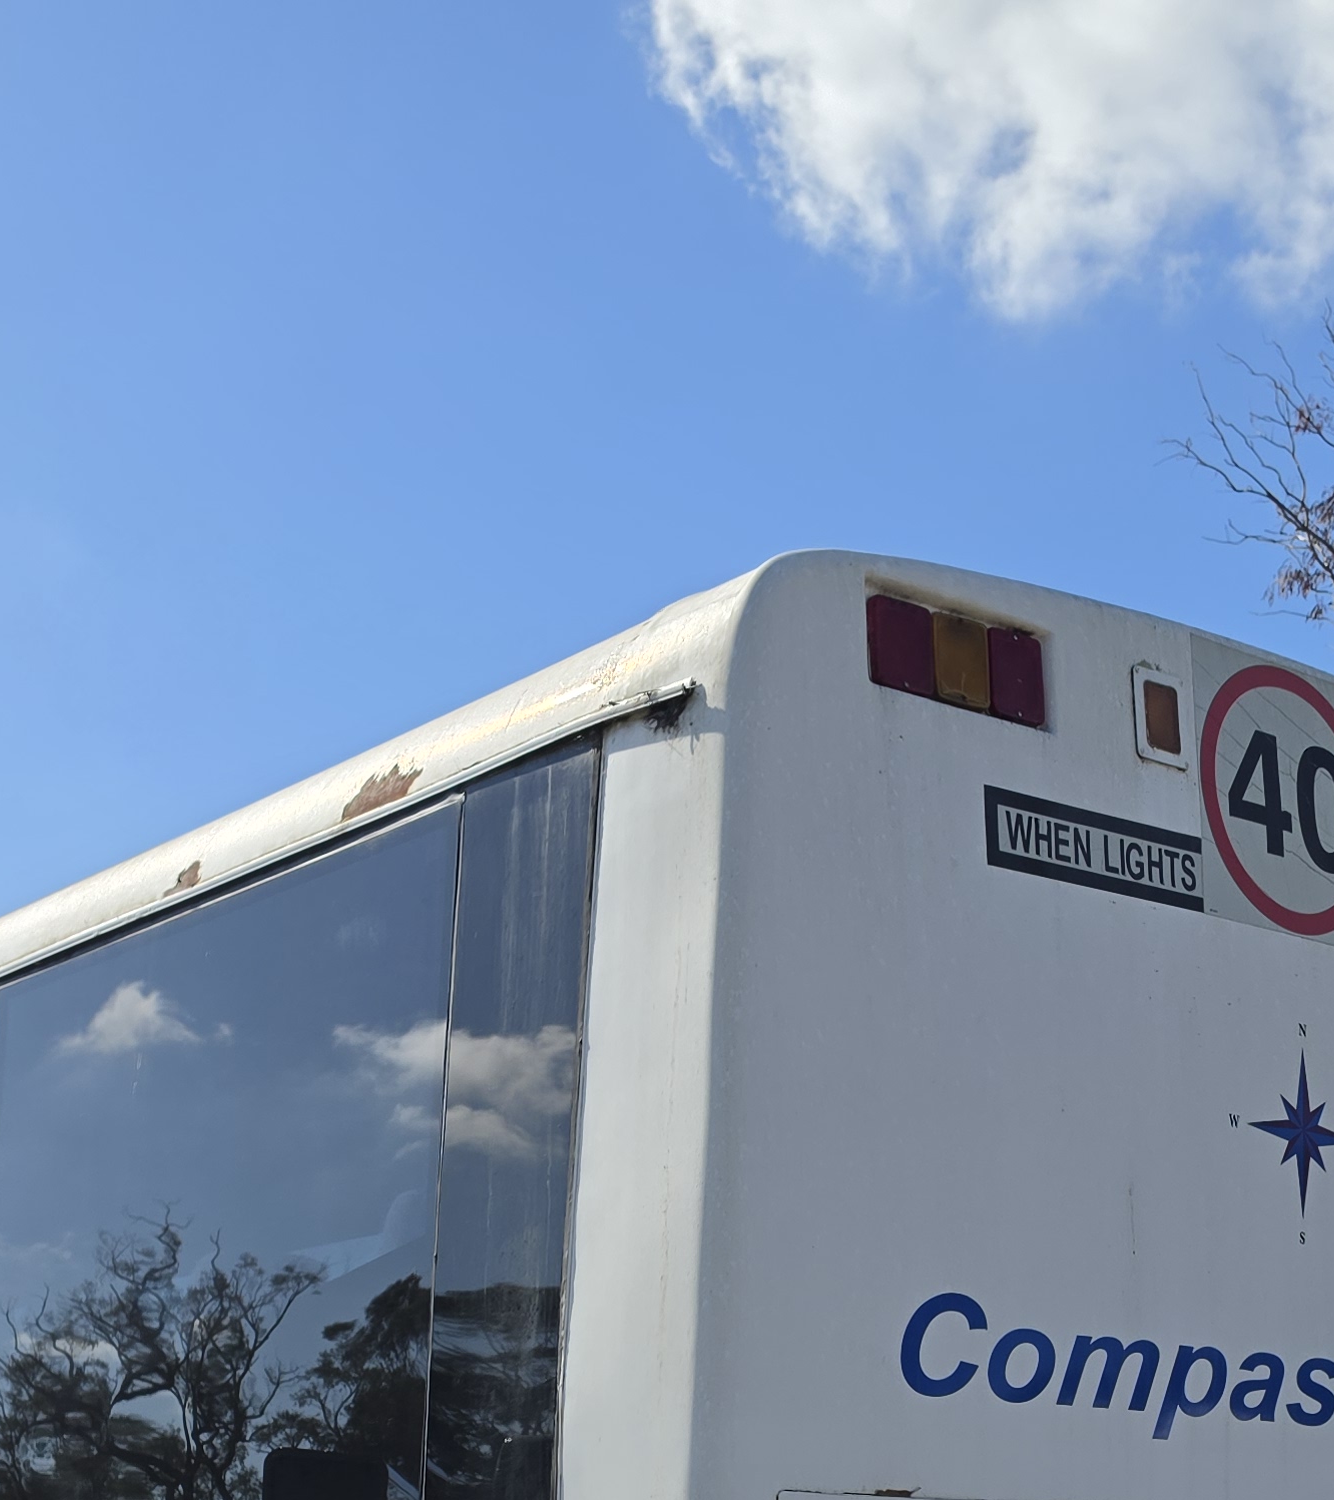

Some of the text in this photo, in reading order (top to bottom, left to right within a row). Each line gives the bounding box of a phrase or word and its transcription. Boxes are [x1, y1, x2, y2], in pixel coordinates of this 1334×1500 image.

[1005, 810, 1197, 893] WHEN LIGHTS
[1298, 1022, 1307, 1038] N
[1228, 1113, 1241, 1129] W
[1299, 1230, 1307, 1246] S
